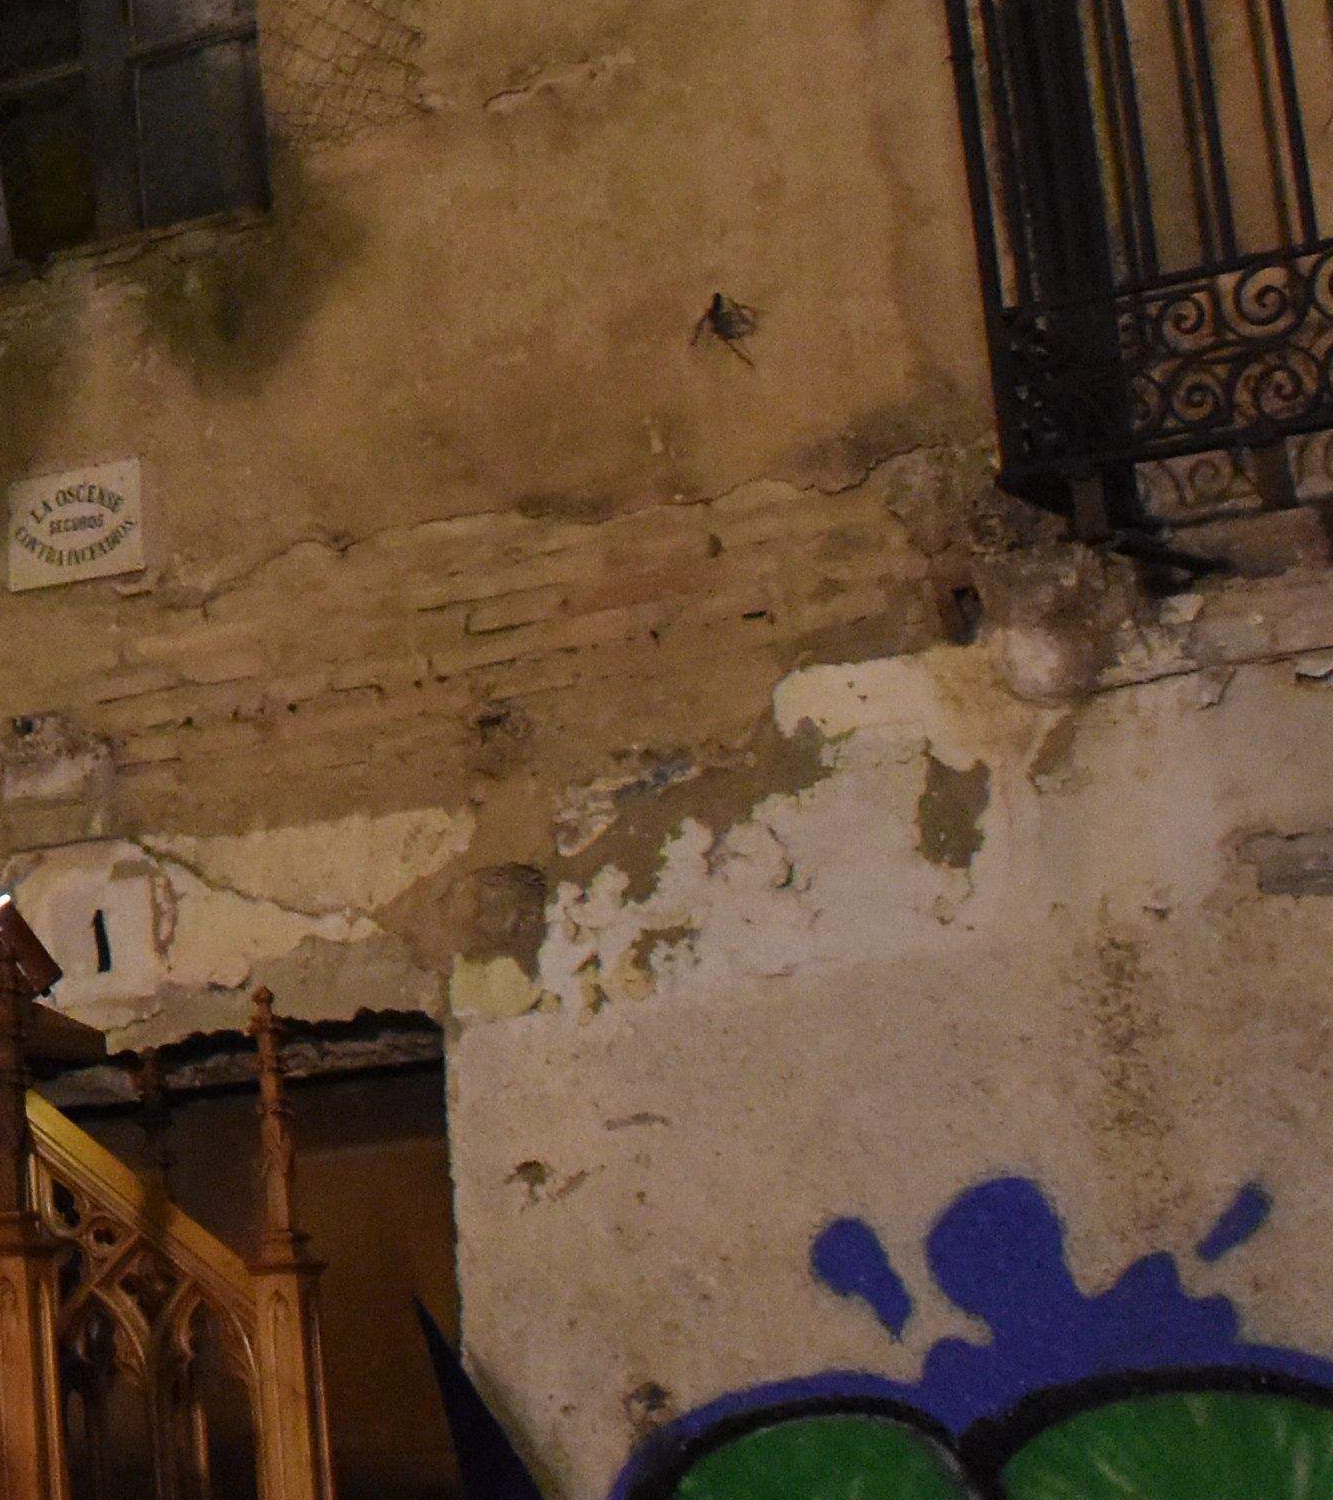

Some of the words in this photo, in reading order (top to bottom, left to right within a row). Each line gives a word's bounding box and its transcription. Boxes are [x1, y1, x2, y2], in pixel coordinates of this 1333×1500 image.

[30, 500, 53, 524] LA
[55, 483, 125, 513] OSCENSE
[15, 526, 63, 566] CONTRA
